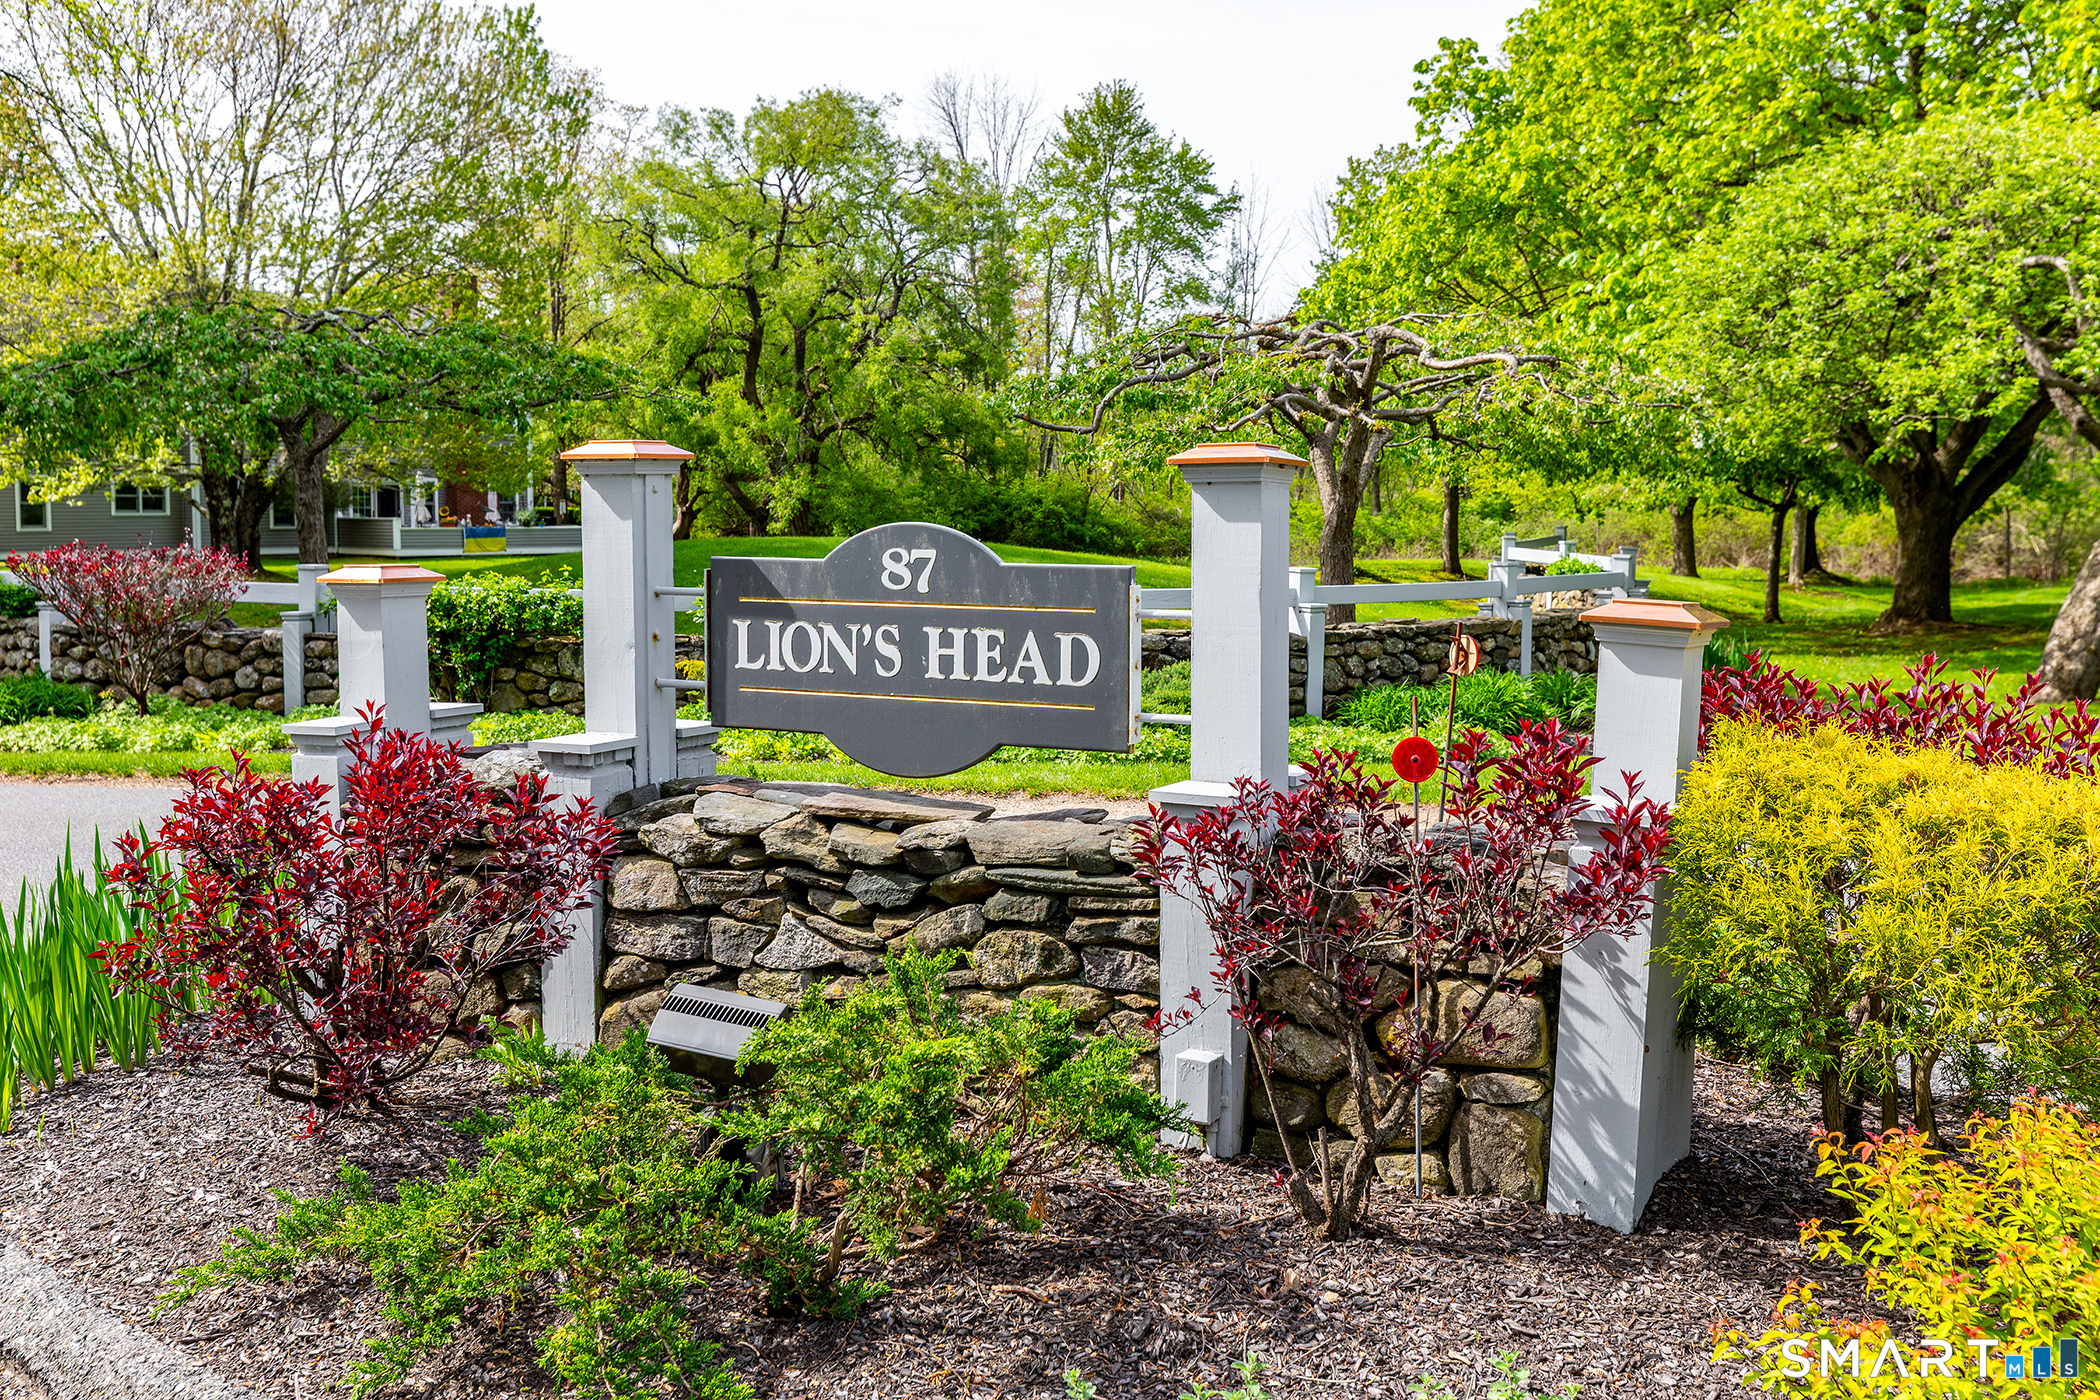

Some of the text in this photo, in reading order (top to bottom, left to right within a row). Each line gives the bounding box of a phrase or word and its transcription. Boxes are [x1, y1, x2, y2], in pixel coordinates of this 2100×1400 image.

[880, 547, 937, 594] 87
[732, 618, 1102, 688] LION'S HEAD
